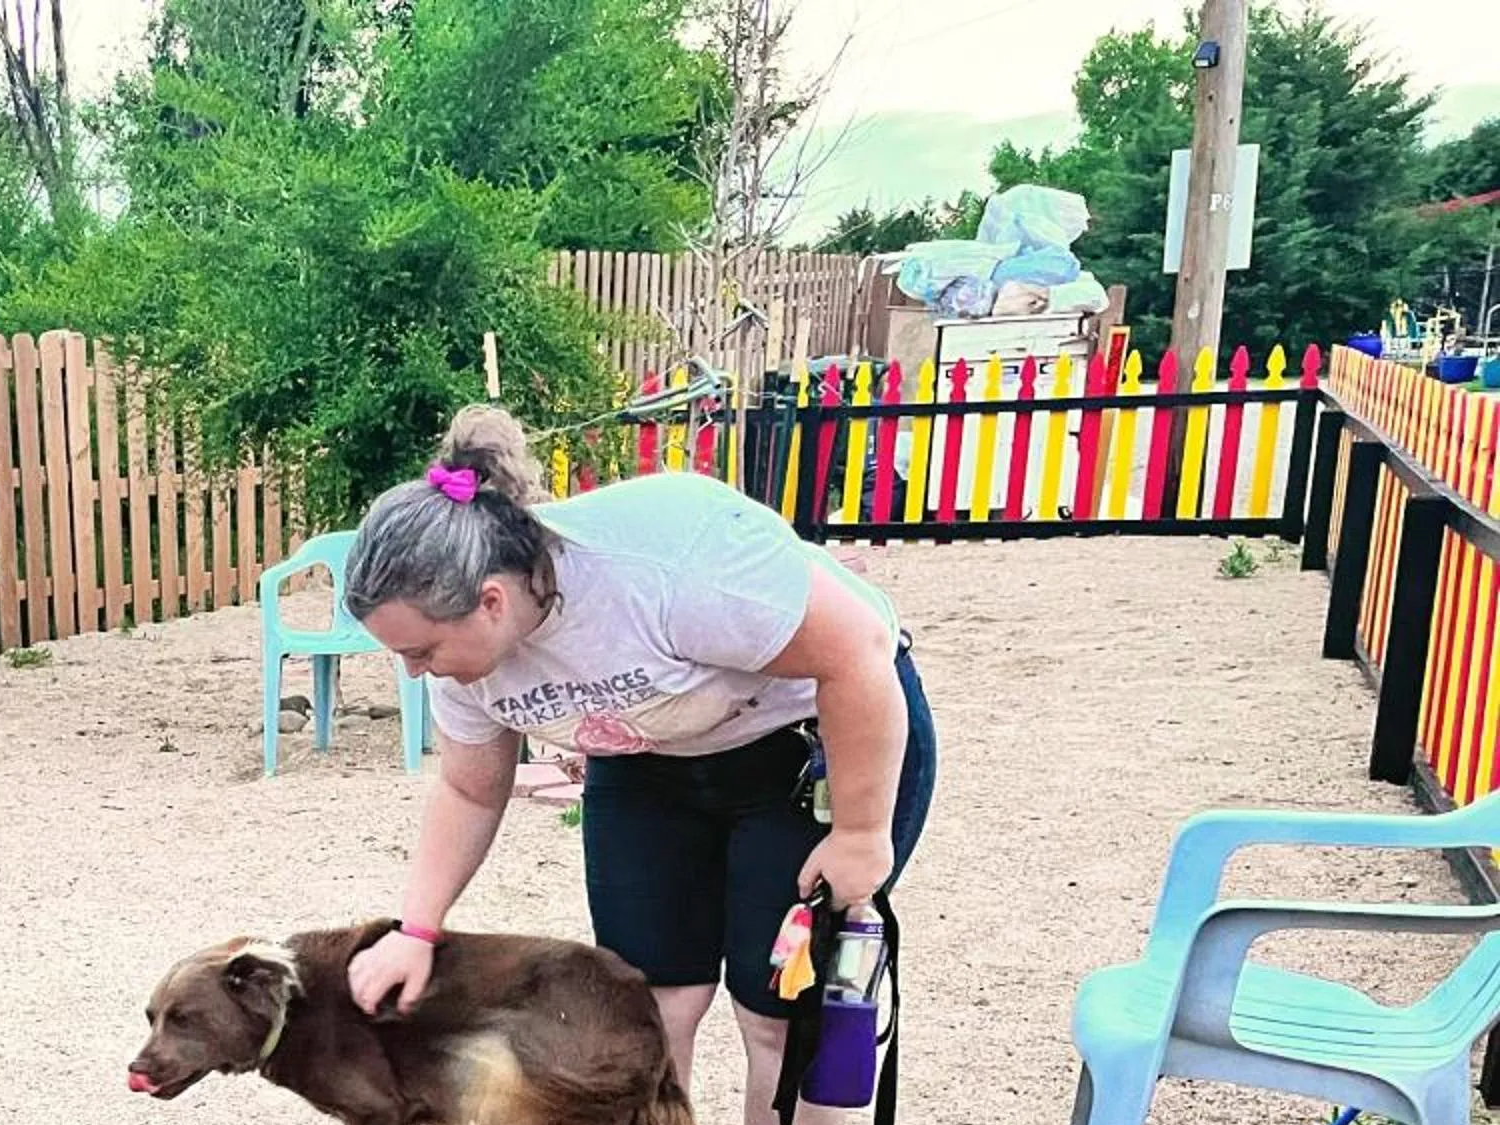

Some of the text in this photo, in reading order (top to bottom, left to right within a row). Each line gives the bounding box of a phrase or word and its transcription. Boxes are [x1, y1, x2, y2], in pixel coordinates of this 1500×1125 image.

[492, 667, 651, 713] TAKE HANCES
[501, 701, 567, 727] MAKE
